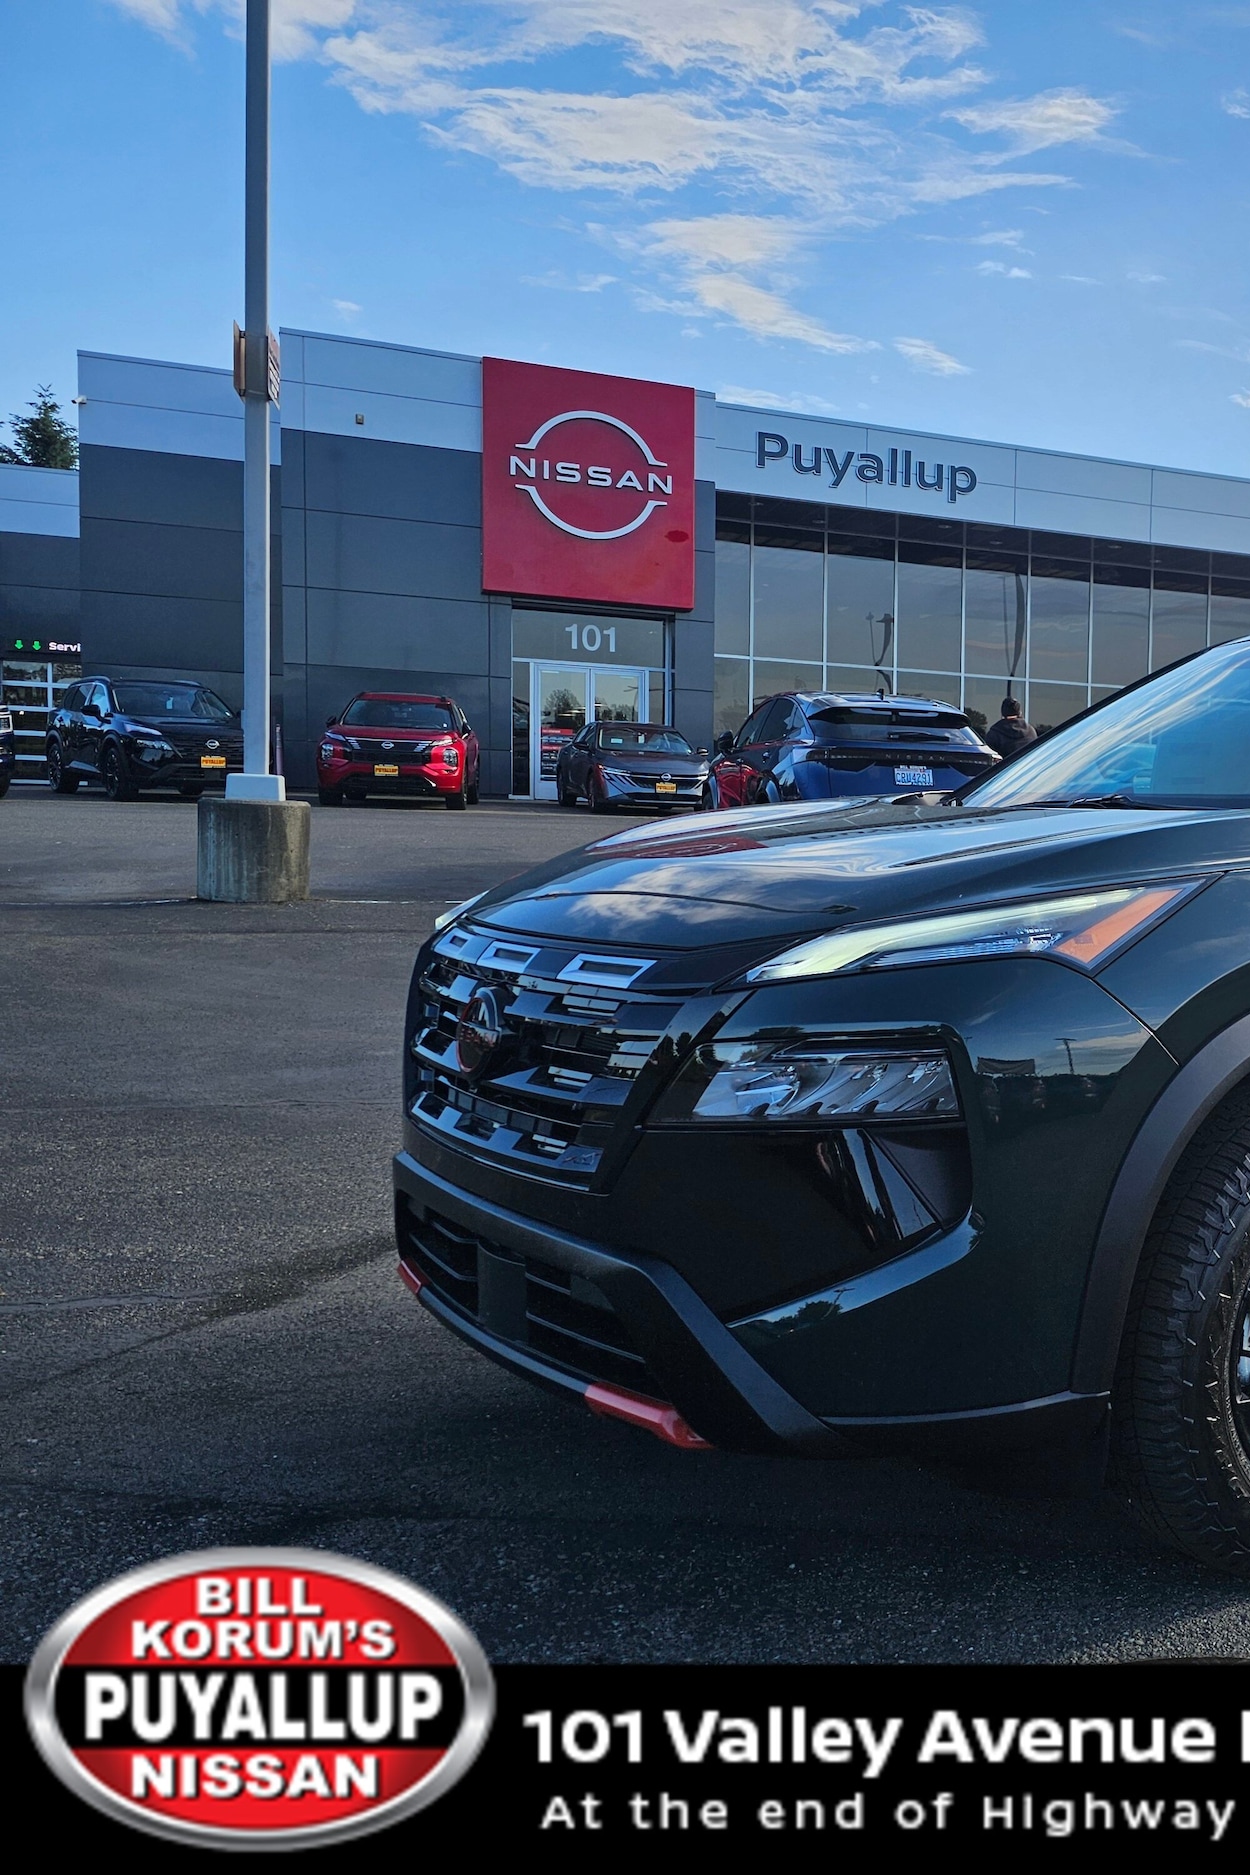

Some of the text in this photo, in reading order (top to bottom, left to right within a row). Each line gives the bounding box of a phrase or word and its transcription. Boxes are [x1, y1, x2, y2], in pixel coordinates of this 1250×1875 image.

[510, 455, 673, 494] NISSAN
[756, 431, 977, 503] Puyallup
[565, 623, 616, 653] 101
